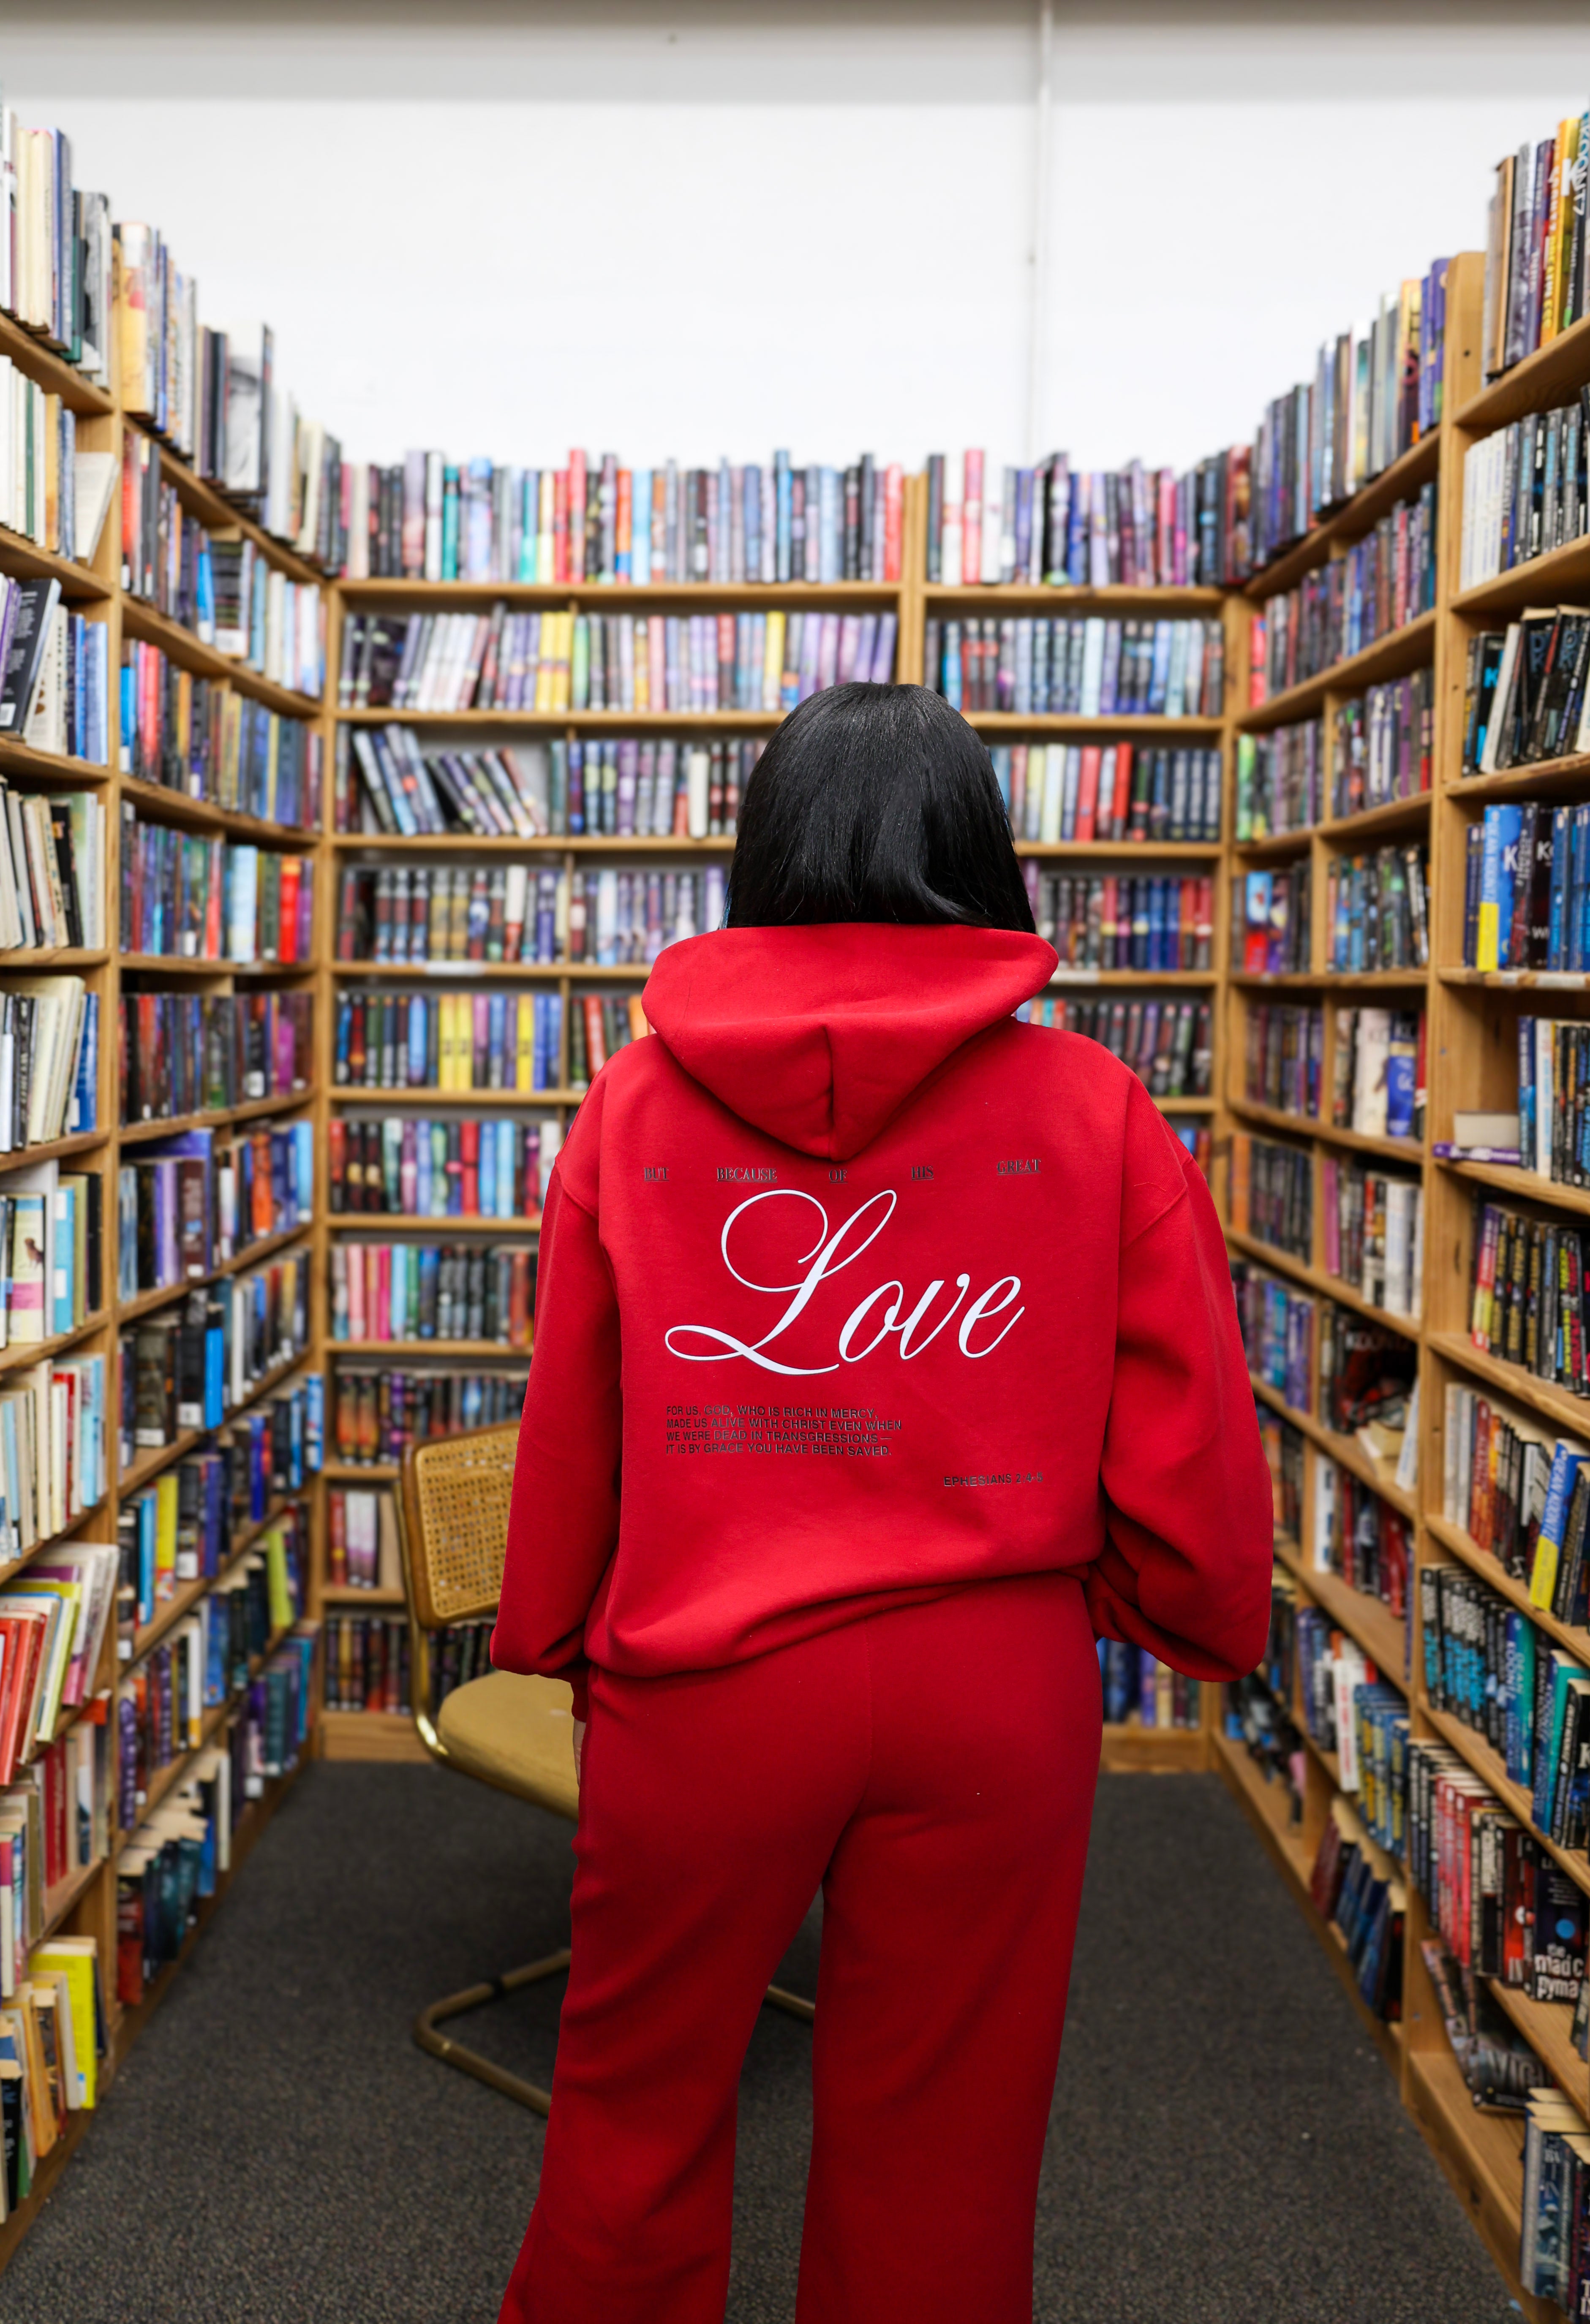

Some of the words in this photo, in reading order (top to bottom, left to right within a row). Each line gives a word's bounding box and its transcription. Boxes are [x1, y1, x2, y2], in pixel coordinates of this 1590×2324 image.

[644, 1167, 669, 1181] BUT
[716, 1167, 777, 1182] BECAUSE
[828, 1169, 847, 1183] OF
[911, 1166, 934, 1180] HIS
[997, 1159, 1041, 1175] GREAT
[665, 1189, 1025, 1375] Love
[667, 1405, 683, 1416] FOR
[686, 1406, 701, 1416] US,
[704, 1405, 734, 1416] GOD,
[737, 1405, 765, 1416] WHO
[768, 1406, 780, 1416] IS
[783, 1407, 812, 1417] RICH
[816, 1408, 828, 1418] IN
[831, 1408, 878, 1419] MERCY,
[667, 1418, 692, 1428] MADE
[694, 1418, 707, 1428] US
[711, 1417, 745, 1428] ALIVE
[749, 1418, 778, 1428] WITH
[781, 1419, 825, 1430] CHRIST
[829, 1420, 861, 1431] EVEN
[865, 1420, 901, 1431] WHEN
[667, 1431, 680, 1441] WE
[683, 1430, 711, 1441] WERE
[714, 1430, 747, 1440] DEAD
[751, 1431, 762, 1441] IN
[766, 1431, 878, 1443] TRANSGRESSIONS
[666, 1444, 675, 1454] IT
[678, 1444, 686, 1454] IS
[689, 1444, 700, 1454] BY
[704, 1443, 743, 1453] GRACE
[747, 1443, 772, 1453] YOU
[776, 1443, 809, 1454] HAVE
[812, 1444, 844, 1455] BEEN
[847, 1446, 892, 1456] SAVED.
[944, 1473, 1012, 1487] EPHESIANS
[1015, 1472, 1044, 1484] 2:4-5
